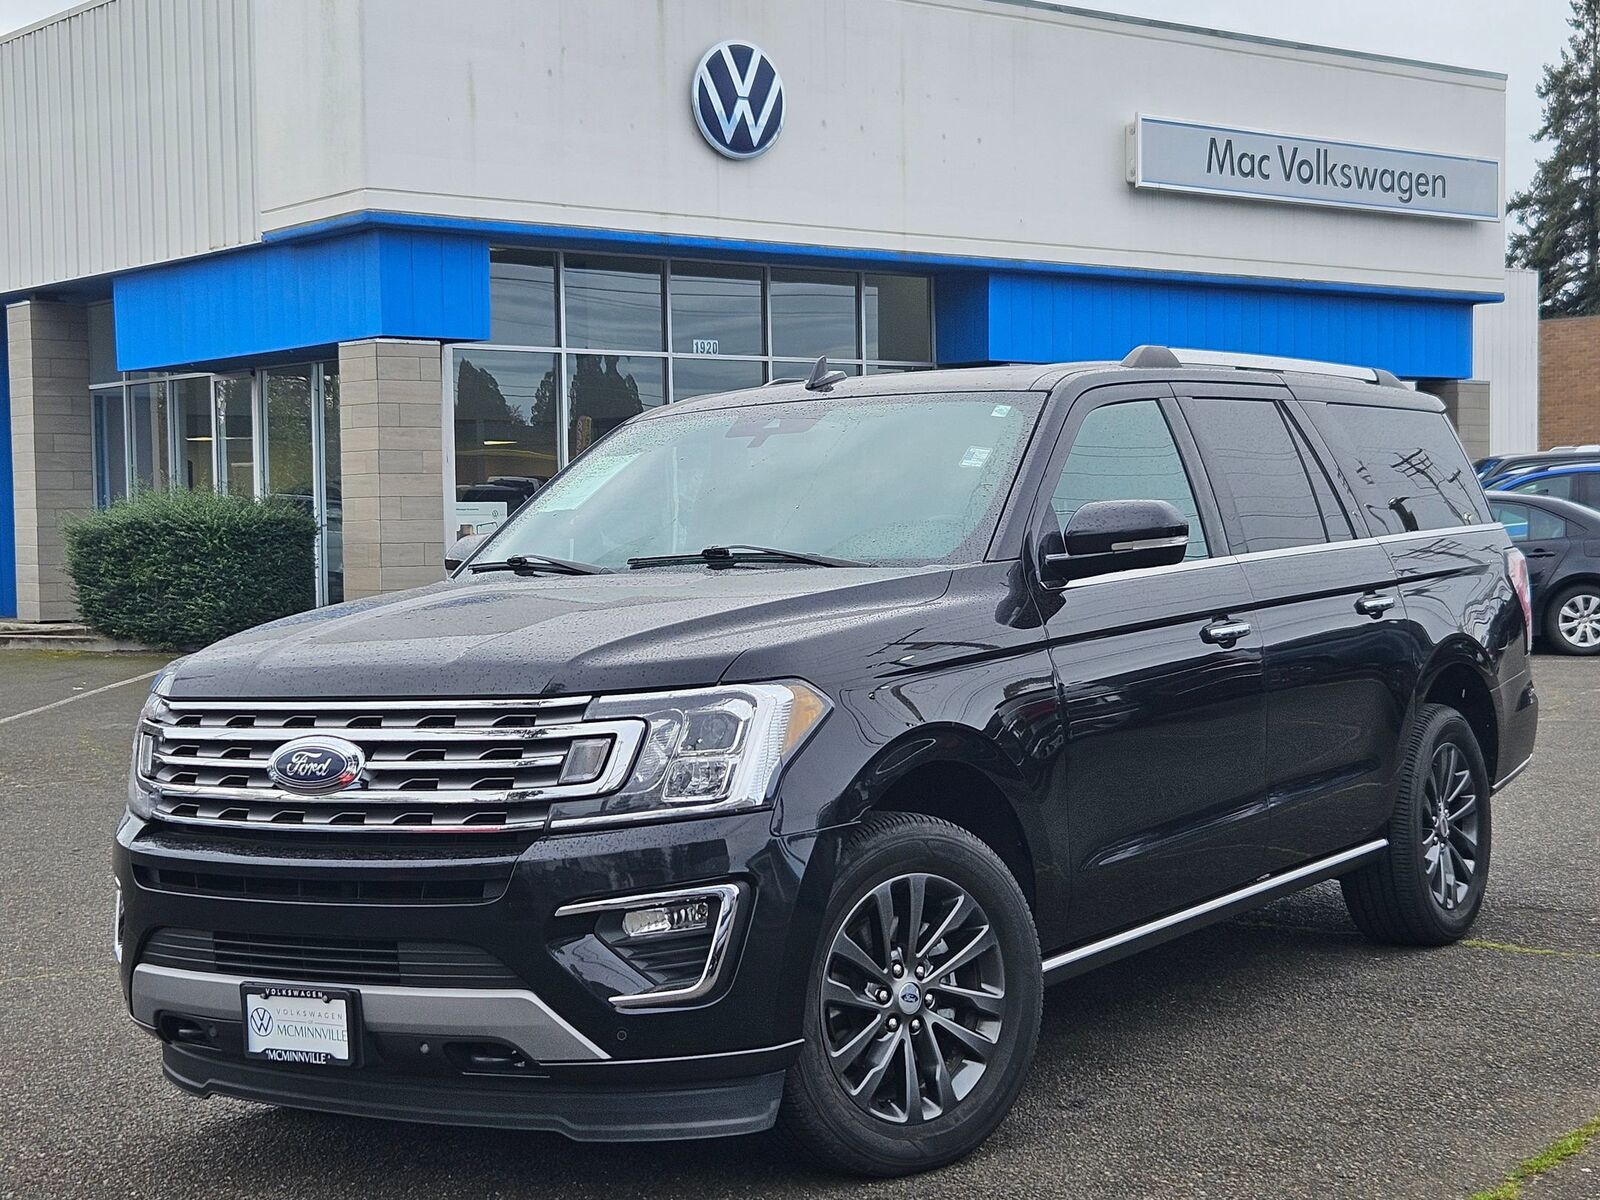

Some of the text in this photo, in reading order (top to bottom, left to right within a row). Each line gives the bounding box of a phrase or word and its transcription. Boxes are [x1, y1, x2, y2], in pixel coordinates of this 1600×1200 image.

[1205, 137, 1446, 203] Mac Volkswagen
[694, 341, 718, 354] 1920
[286, 751, 332, 776] Ford
[265, 988, 323, 998] VOLKSWAGEN
[276, 1008, 343, 1020] VOLKSWAGEN
[277, 1024, 347, 1042] MCMINNVILLE
[267, 1050, 327, 1064] MCMINNVILLE
